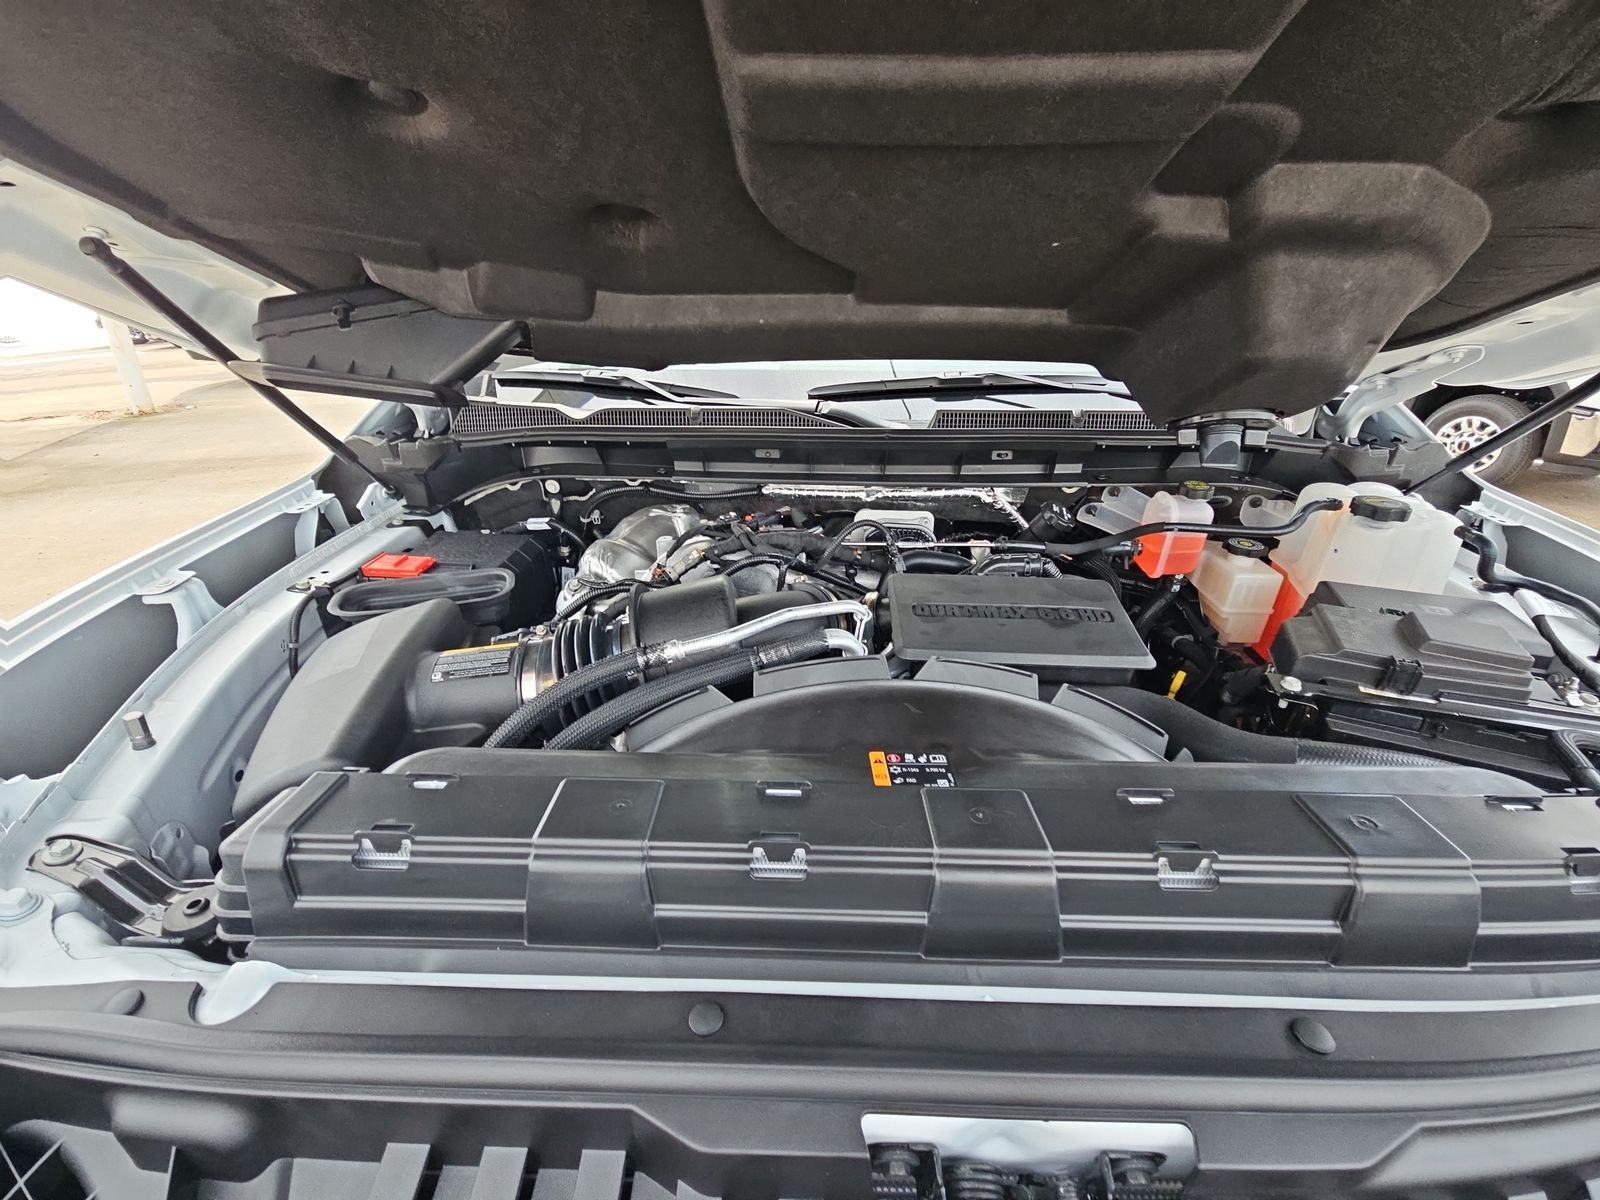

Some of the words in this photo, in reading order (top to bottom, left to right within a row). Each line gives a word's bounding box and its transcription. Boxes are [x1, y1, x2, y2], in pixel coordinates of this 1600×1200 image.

[914, 604, 1027, 620] DURAMAX
[1036, 608, 1074, 622] 6.6
[1079, 609, 1115, 624] HD
